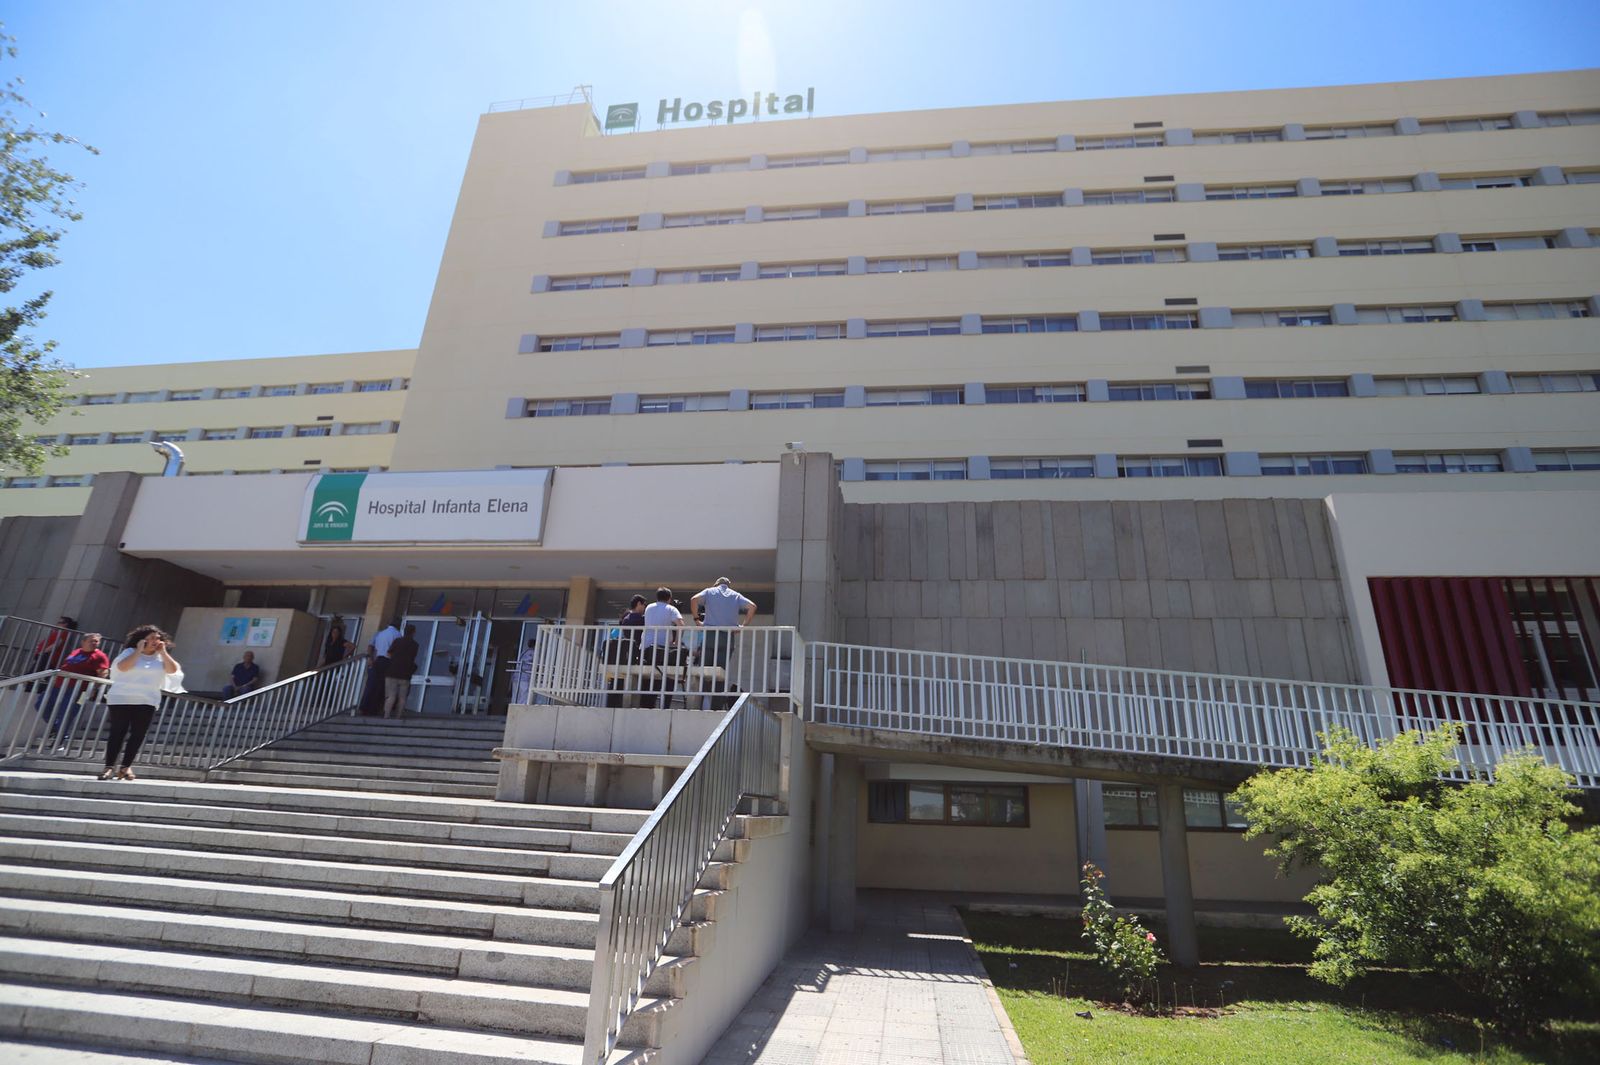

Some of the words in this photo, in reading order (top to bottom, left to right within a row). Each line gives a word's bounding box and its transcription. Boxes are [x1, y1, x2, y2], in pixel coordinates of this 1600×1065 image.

[657, 87, 815, 124] Hospital
[368, 500, 426, 517] Hospital
[432, 499, 481, 514] Infanta
[487, 498, 529, 513] Elena
